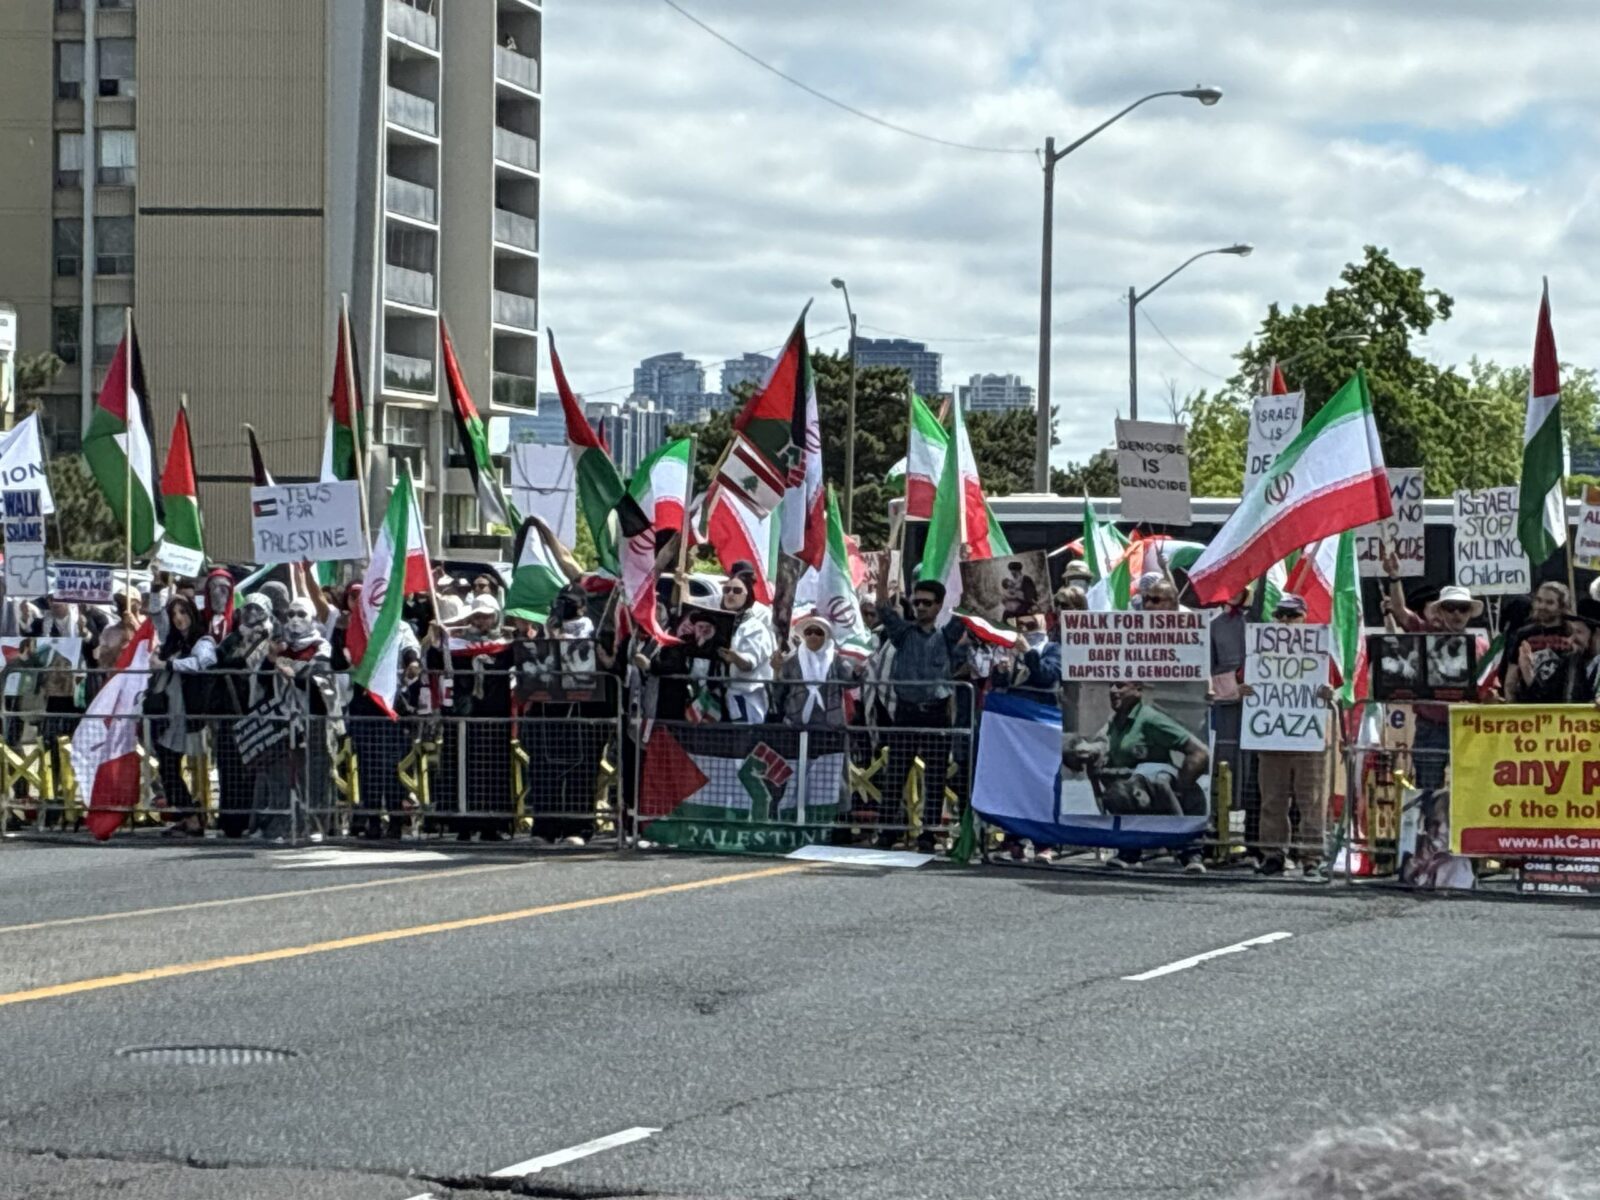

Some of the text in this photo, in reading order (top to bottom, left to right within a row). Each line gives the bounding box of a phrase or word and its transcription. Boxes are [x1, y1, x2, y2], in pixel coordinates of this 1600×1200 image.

[1256, 407, 1298, 423] ISRAEL
[1270, 427, 1283, 441] IS
[1119, 439, 1185, 455] GENOCIDE
[1142, 458, 1160, 474] IS
[1121, 476, 1187, 492] GENOCIDE
[4, 491, 41, 517] WALK
[280, 486, 332, 505] JEWS
[1459, 491, 1520, 517] ISRAEL
[286, 505, 313, 521] FOR
[7, 522, 42, 542] SHAME
[1464, 515, 1513, 538] STOP
[259, 527, 348, 553] PALESTINE
[1458, 562, 1525, 587] Children
[57, 580, 112, 591] SHAME
[1064, 614, 1206, 629] WALK FOR ISREAL
[1066, 632, 1204, 646] FOR WAR CRIMINALS,
[1254, 627, 1328, 655] ISRAEL
[1088, 649, 1181, 662] BABY KILLERS,
[1069, 665, 1202, 678] RAPISTS & GENOCIDE
[1258, 656, 1319, 679] STOP
[1250, 709, 1324, 739] GAZA
[1559, 714, 1600, 734] has
[1514, 735, 1592, 753] to rule
[1493, 760, 1571, 795] any
[1488, 799, 1512, 818] of
[1520, 799, 1558, 818] the
[1524, 862, 1600, 873] ONE CAUSE
